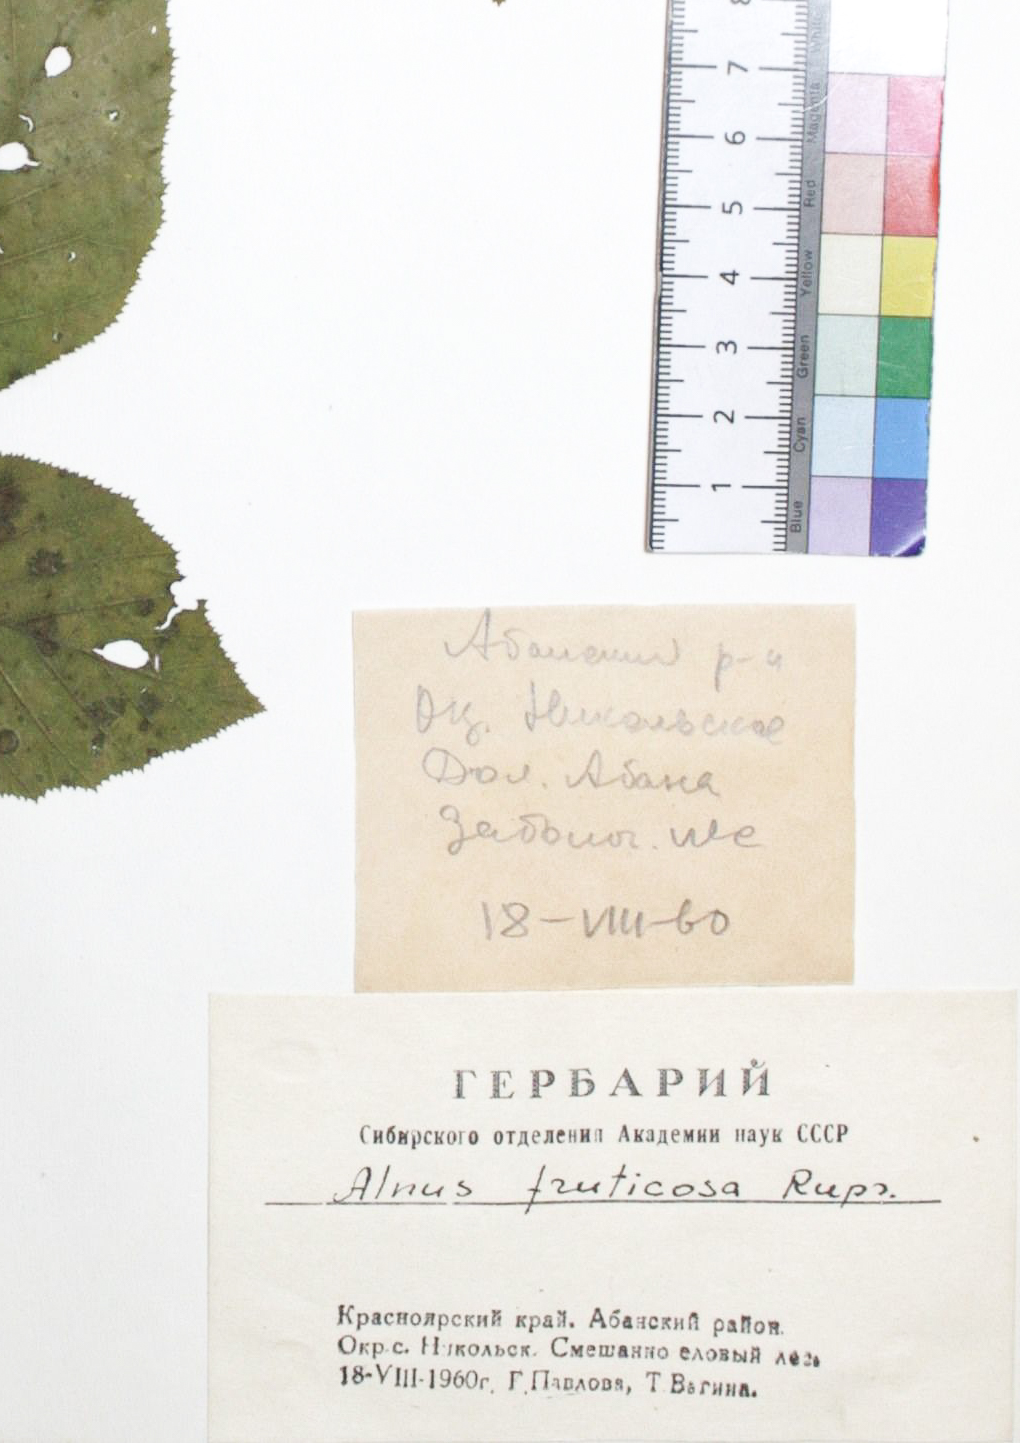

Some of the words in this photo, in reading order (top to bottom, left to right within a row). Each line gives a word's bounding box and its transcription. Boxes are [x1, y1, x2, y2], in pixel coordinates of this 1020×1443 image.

[726, 59, 749, 76] 7
[723, 130, 747, 146] 6
[803, 176, 818, 209] Red
[720, 200, 744, 216] 5
[718, 268, 741, 287] 4
[800, 247, 815, 297] Yellow
[714, 339, 738, 356] 3
[796, 332, 810, 379] Green
[712, 409, 736, 425] 2
[792, 415, 807, 454] Cyan
[710, 482, 733, 493] 1
[789, 499, 804, 533] Blue
[452, 1057, 771, 1100] ГЕРБАРИЙ
[358, 1124, 480, 1151] Сибирского
[492, 1127, 604, 1148] отделения
[617, 1123, 721, 1147] Академии
[734, 1127, 784, 1149] наук
[796, 1122, 850, 1144] СССР
[333, 1165, 473, 1203] Alnus
[524, 1164, 740, 1214] fruticosa
[782, 1168, 897, 1208] Rupr.
[336, 1303, 503, 1332] Красноярский
[514, 1309, 576, 1334] край.
[588, 1306, 700, 1332] Абанский
[712, 1313, 785, 1339] район.
[550, 1335, 670, 1361] Смешанно
[678, 1345, 762, 1365] еловый
